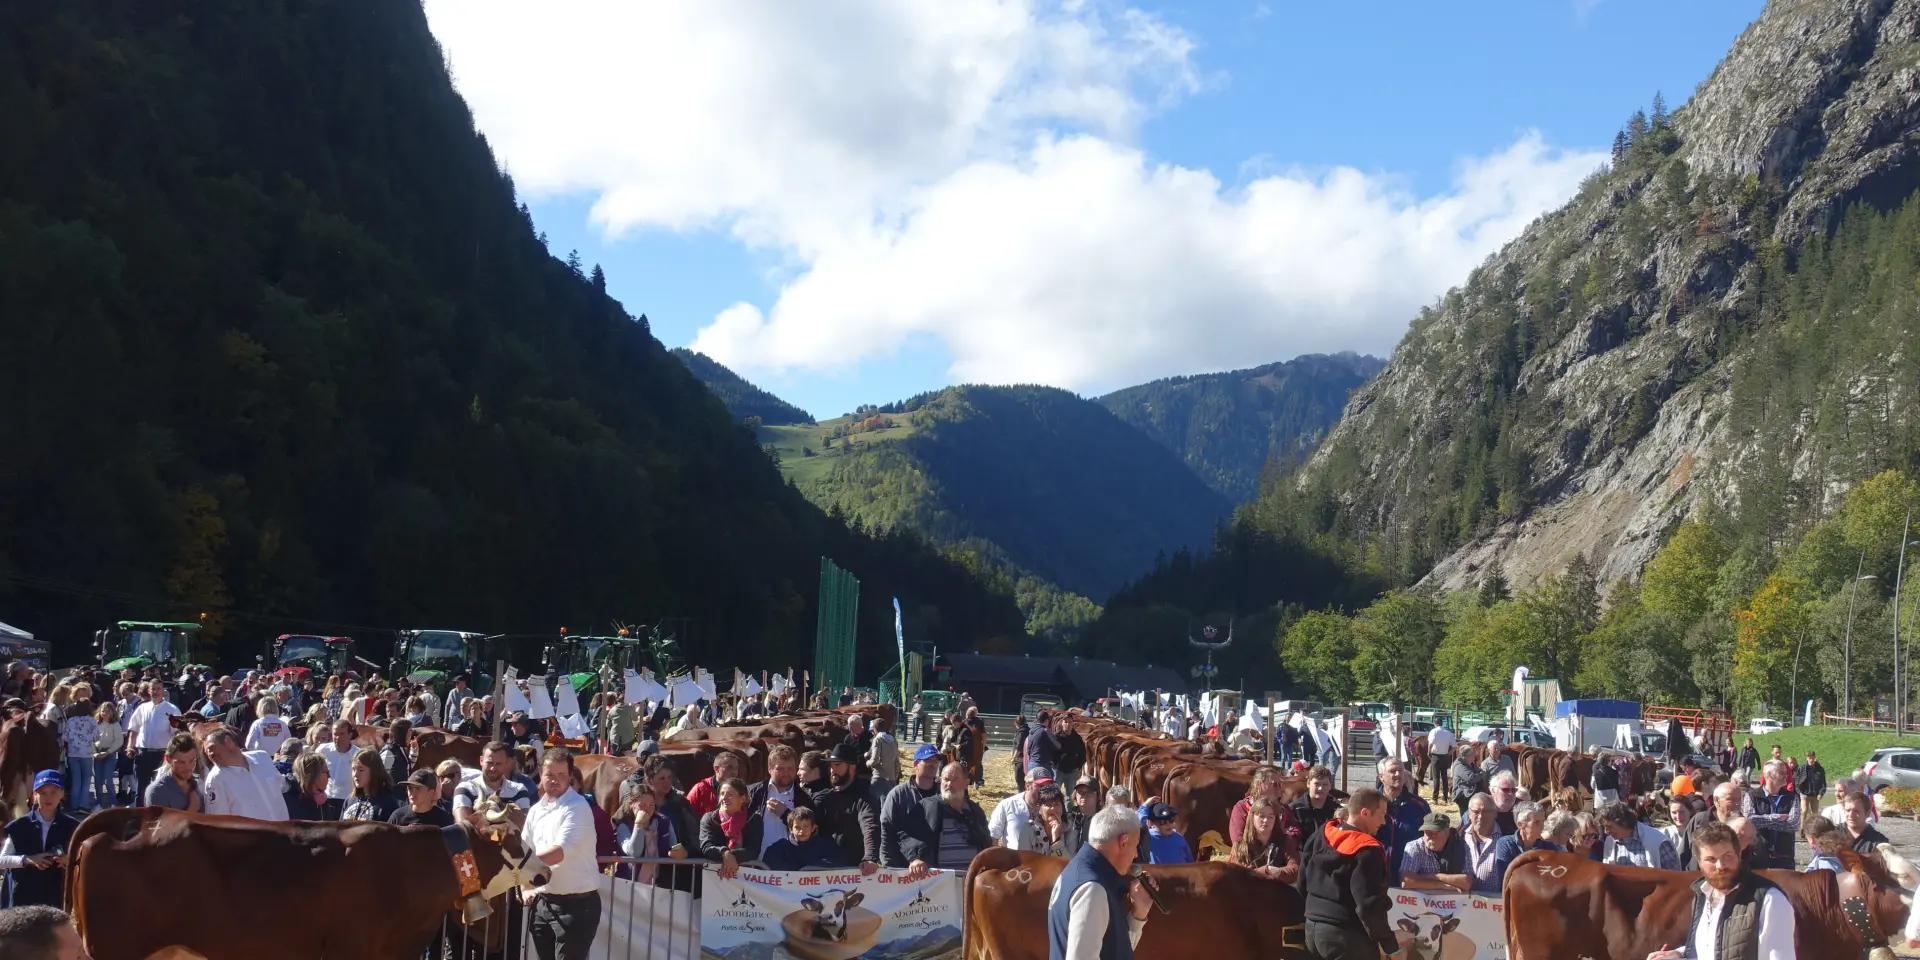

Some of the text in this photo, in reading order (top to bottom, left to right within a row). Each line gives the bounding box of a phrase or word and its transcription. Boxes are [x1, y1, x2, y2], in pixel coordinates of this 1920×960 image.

[1536, 864, 1568, 878] 70
[743, 872, 782, 887] VALLÉE
[798, 876, 821, 886] UNE
[826, 874, 862, 885] VACHE
[877, 873, 893, 884] UN
[1396, 895, 1418, 906] UNE
[1423, 898, 1457, 910] VACHE
[1472, 899, 1488, 910] UN
[713, 908, 773, 919] Abondance
[891, 904, 949, 920] Abondance
